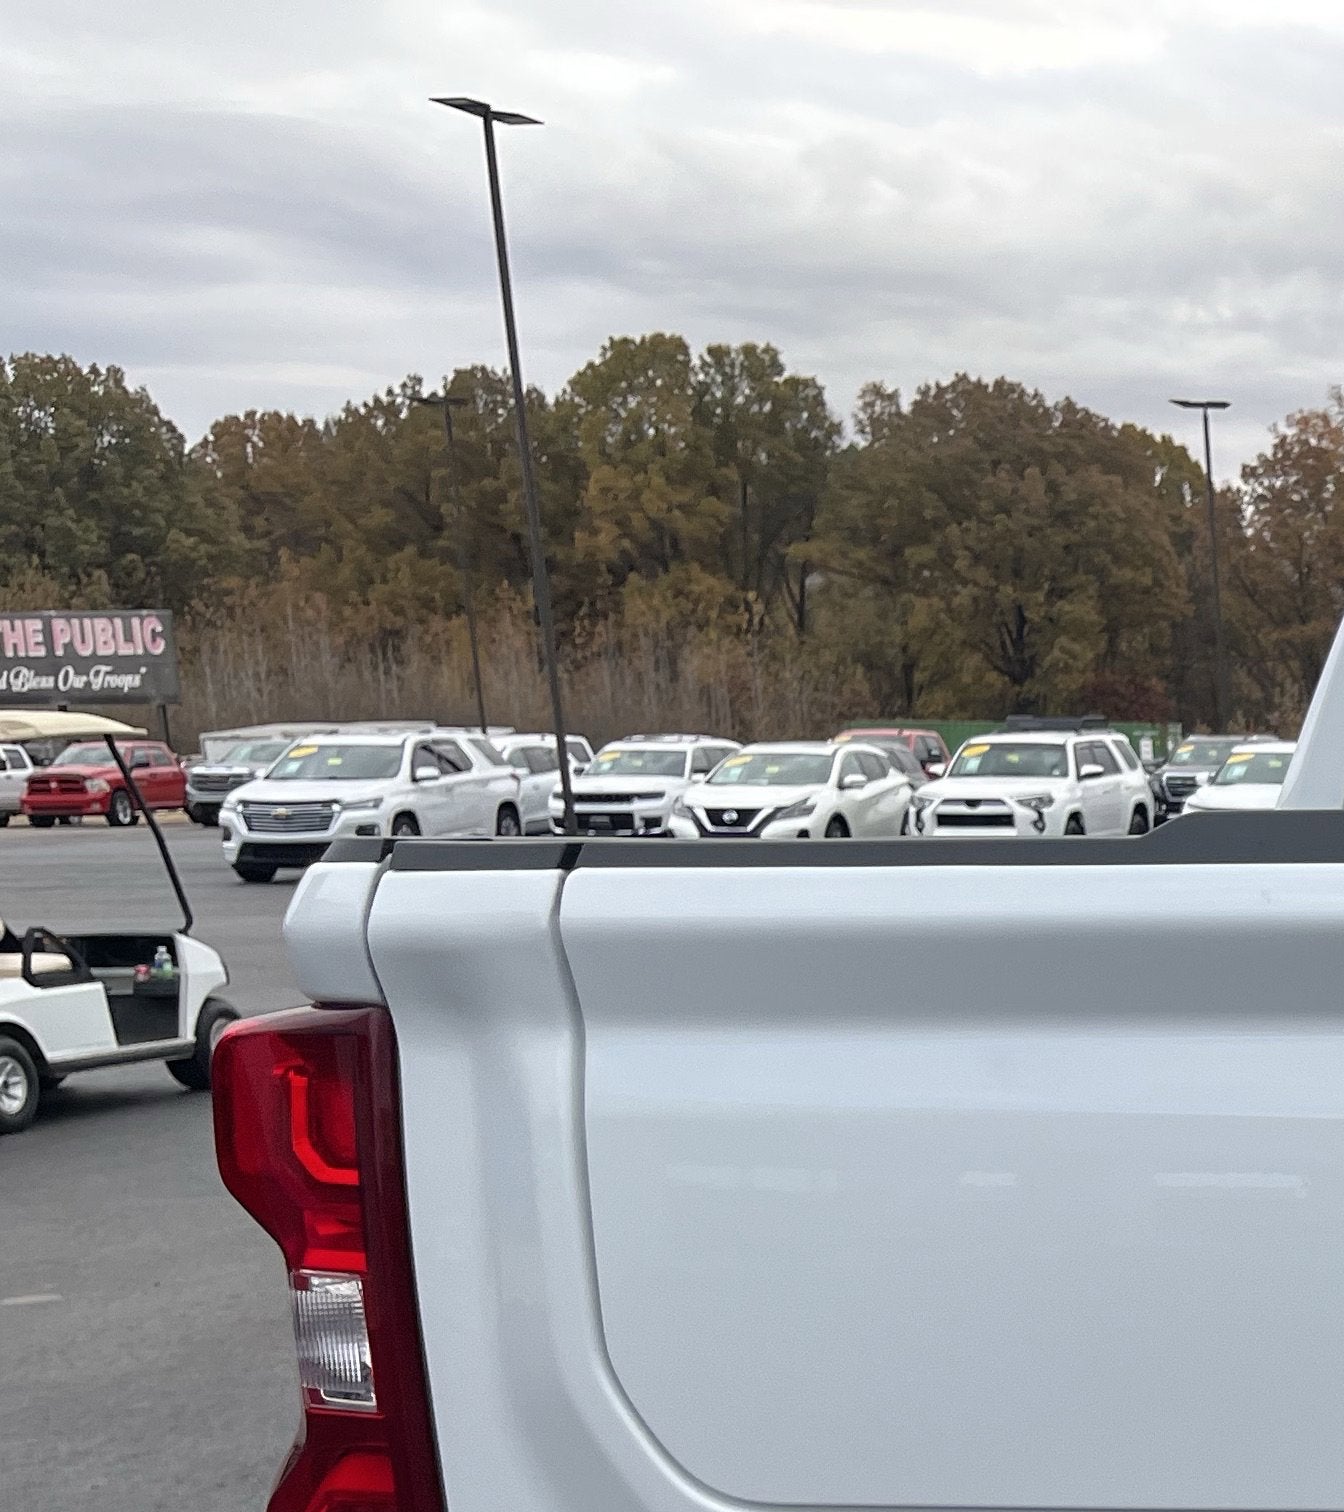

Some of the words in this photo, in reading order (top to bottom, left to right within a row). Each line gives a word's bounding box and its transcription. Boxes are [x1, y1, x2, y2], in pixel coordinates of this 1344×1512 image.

[0, 618, 46, 657] HE
[51, 615, 166, 657] PUBLIC
[9, 665, 55, 693] Bless
[57, 664, 88, 692] Our
